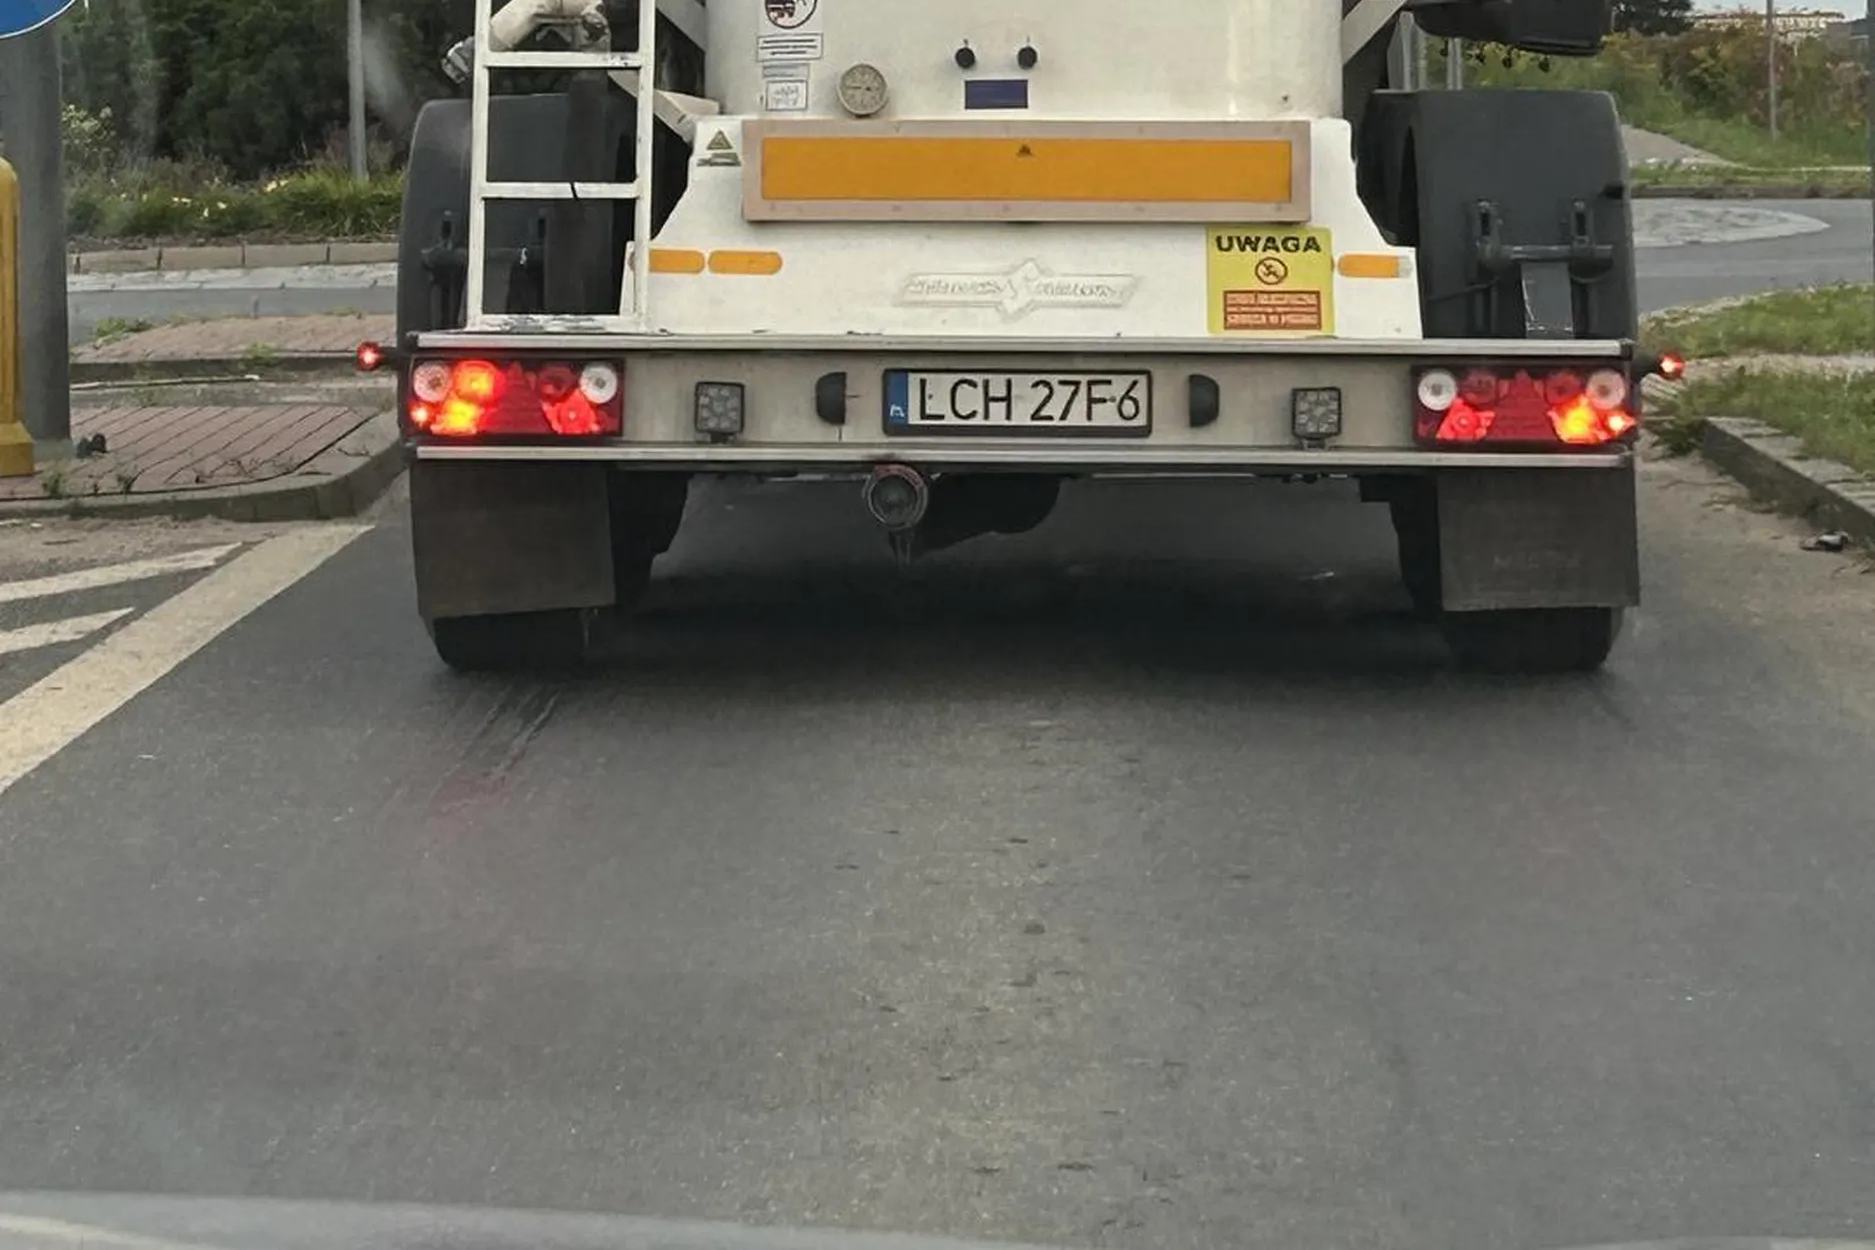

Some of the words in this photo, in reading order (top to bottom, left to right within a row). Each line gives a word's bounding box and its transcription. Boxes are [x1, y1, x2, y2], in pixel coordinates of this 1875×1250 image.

[1216, 235, 1321, 252] UWAGA
[919, 378, 1012, 421] LCH
[1030, 379, 1140, 421] 27F6
